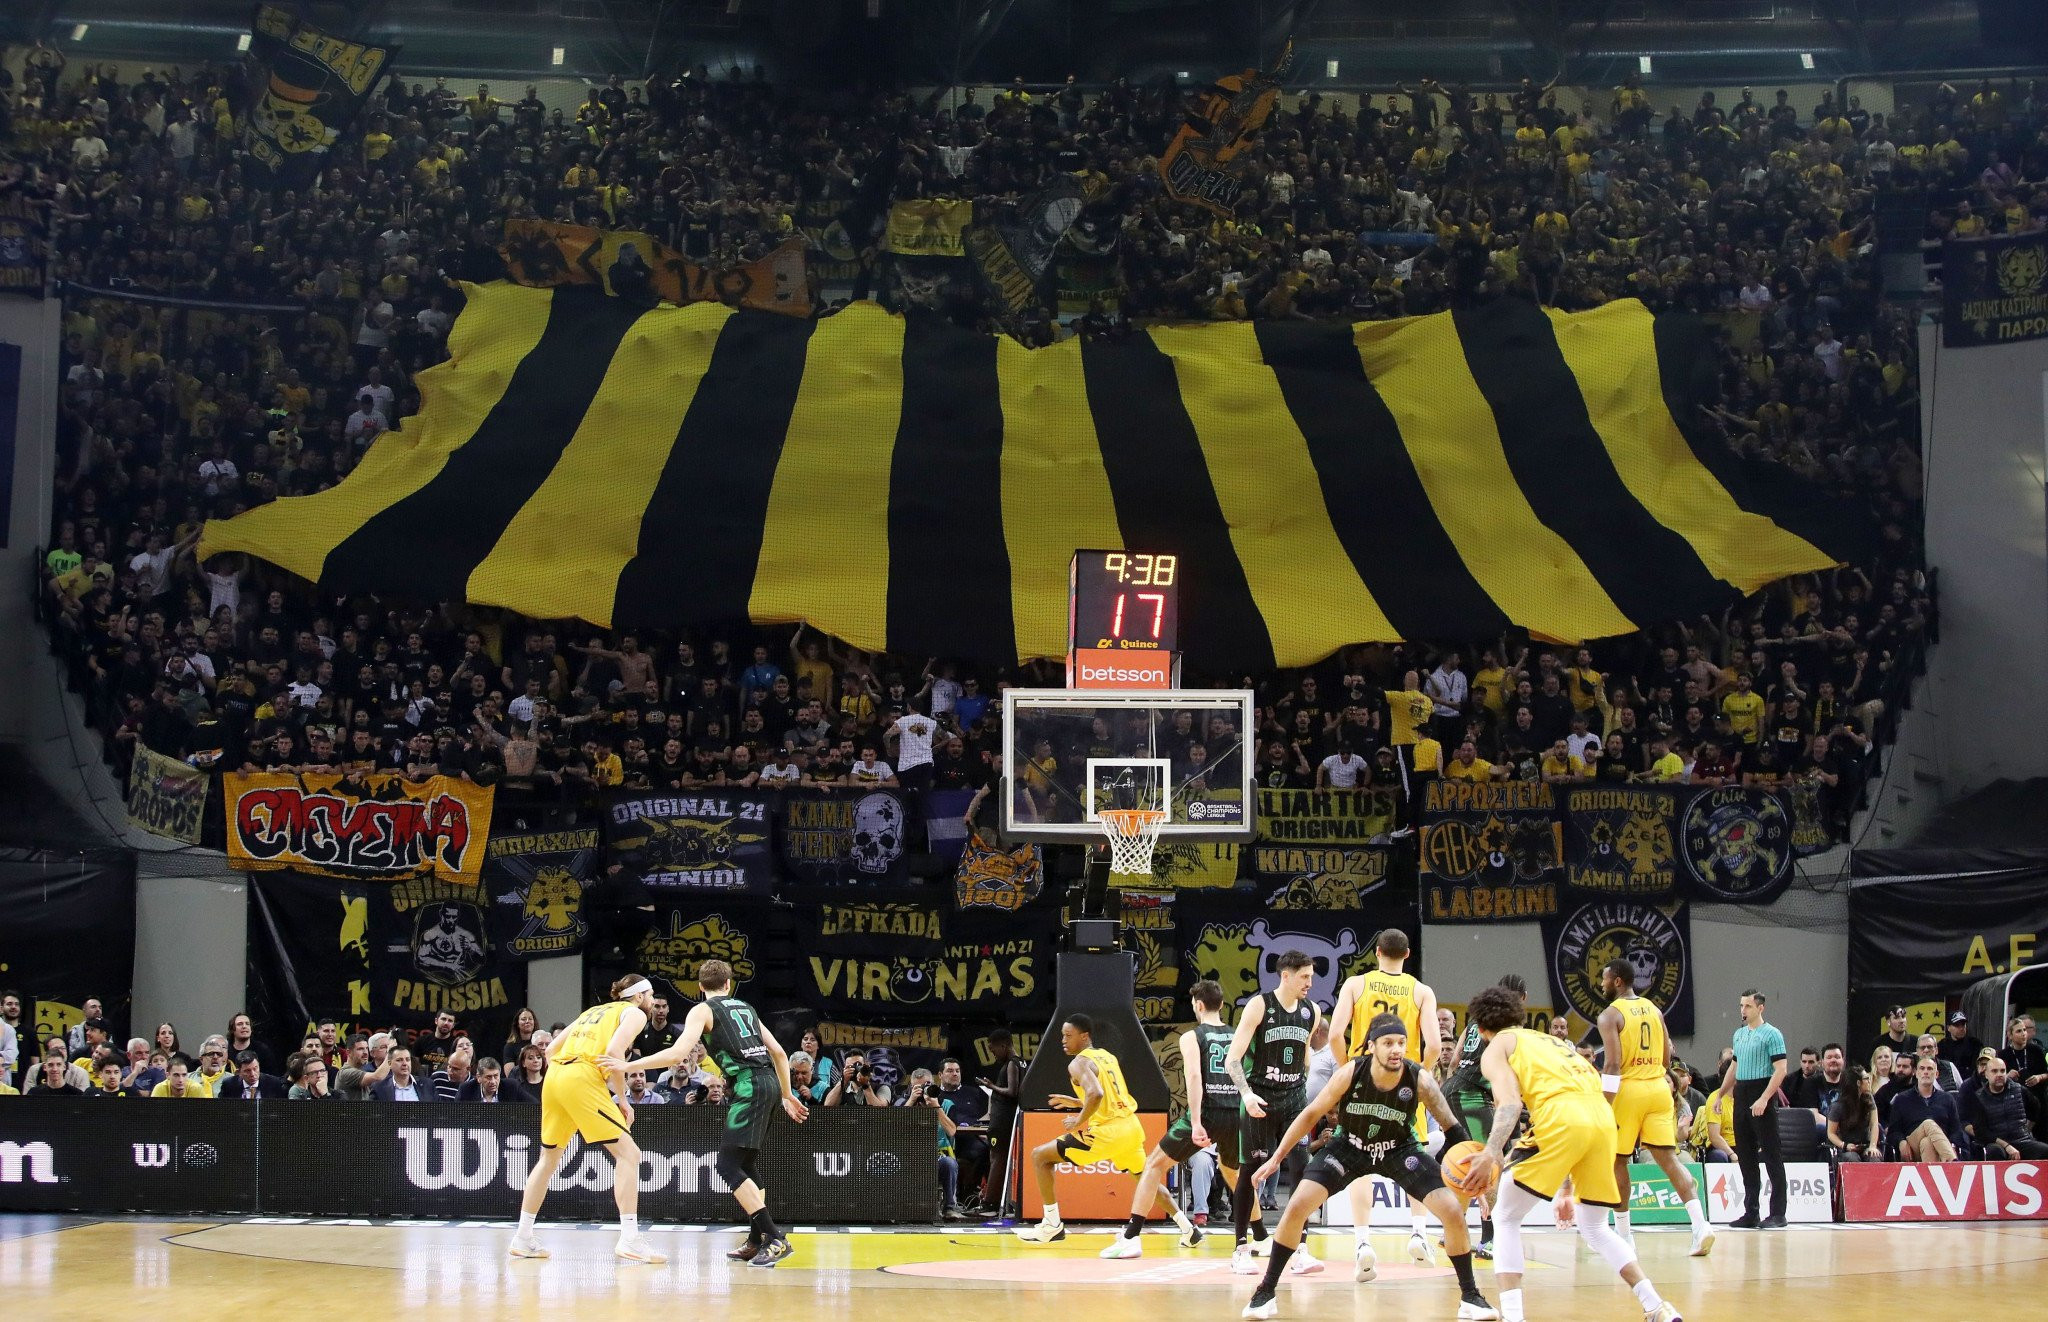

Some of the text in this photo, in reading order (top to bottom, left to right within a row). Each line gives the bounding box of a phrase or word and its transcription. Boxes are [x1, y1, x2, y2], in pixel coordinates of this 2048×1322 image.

[1999, 316, 2048, 339] ΠΑΡΩ
[1105, 553, 1177, 586] 9:38
[1112, 593, 1165, 639] 17
[1120, 639, 1159, 649] Quince
[1081, 664, 1164, 683] betsson
[612, 799, 766, 825] ORIGINAL 21
[1270, 819, 1370, 839] ORIGINAL
[1256, 848, 1385, 876] KIATO 21
[1430, 884, 1557, 919] LABRINI
[821, 903, 942, 940] LEFKADA
[993, 939, 1034, 955] NAZI
[393, 977, 509, 1013] PATISSIA
[1283, 1046, 1294, 1065] 6
[1885, 1164, 2043, 1217] AVIS
